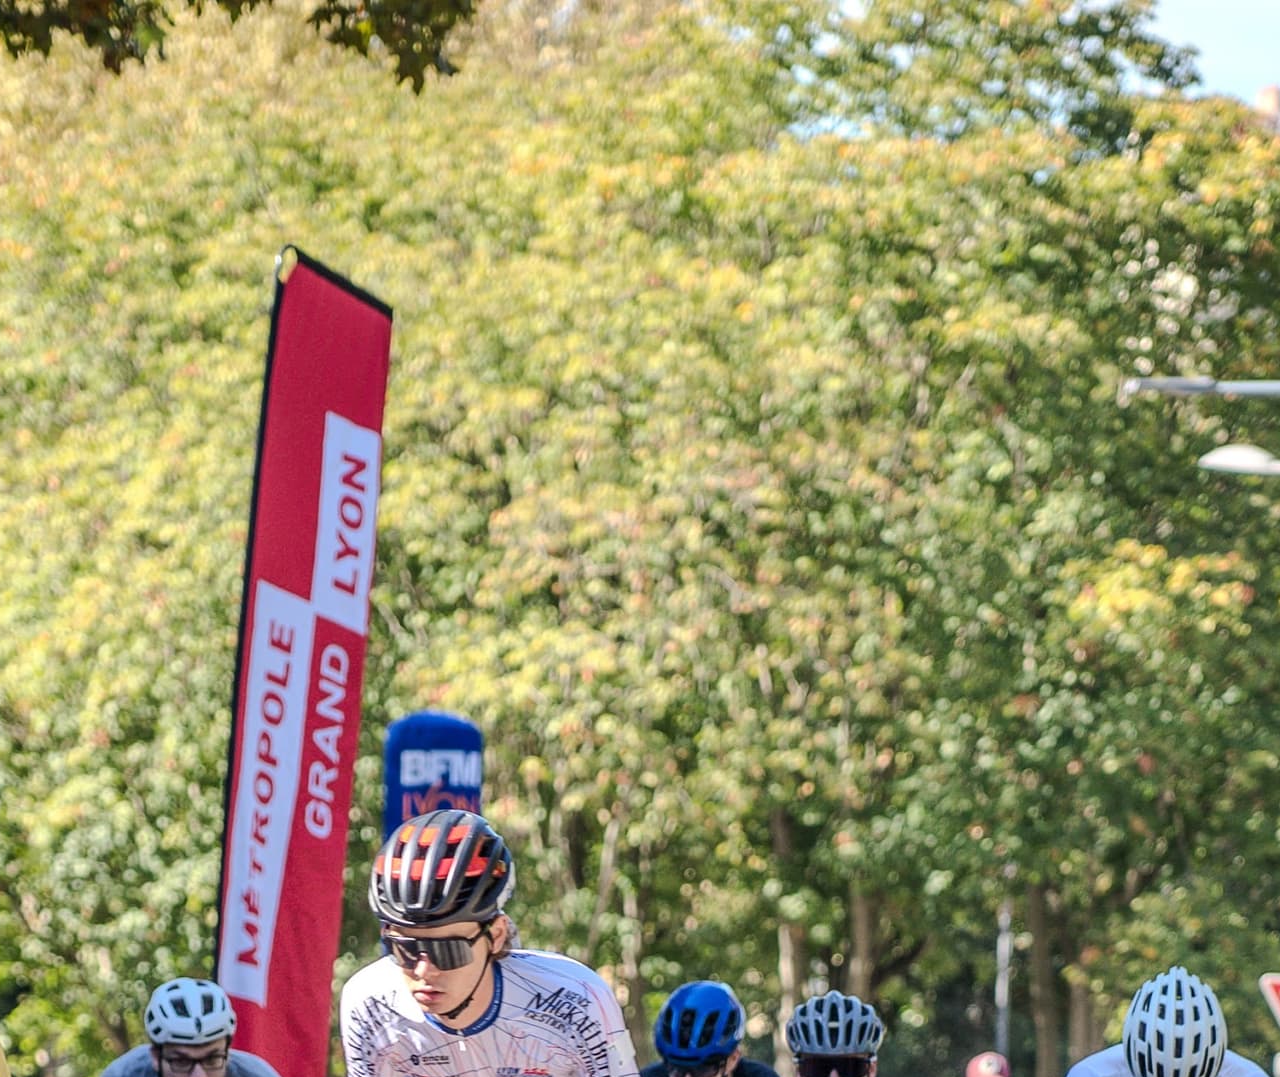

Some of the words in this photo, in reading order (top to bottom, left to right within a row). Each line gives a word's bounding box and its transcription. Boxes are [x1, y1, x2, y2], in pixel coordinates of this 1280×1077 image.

[333, 454, 368, 596] LYON
[236, 619, 295, 967] MÉTROPOLE
[304, 642, 351, 840] GRAND
[400, 749, 482, 787] BFM
